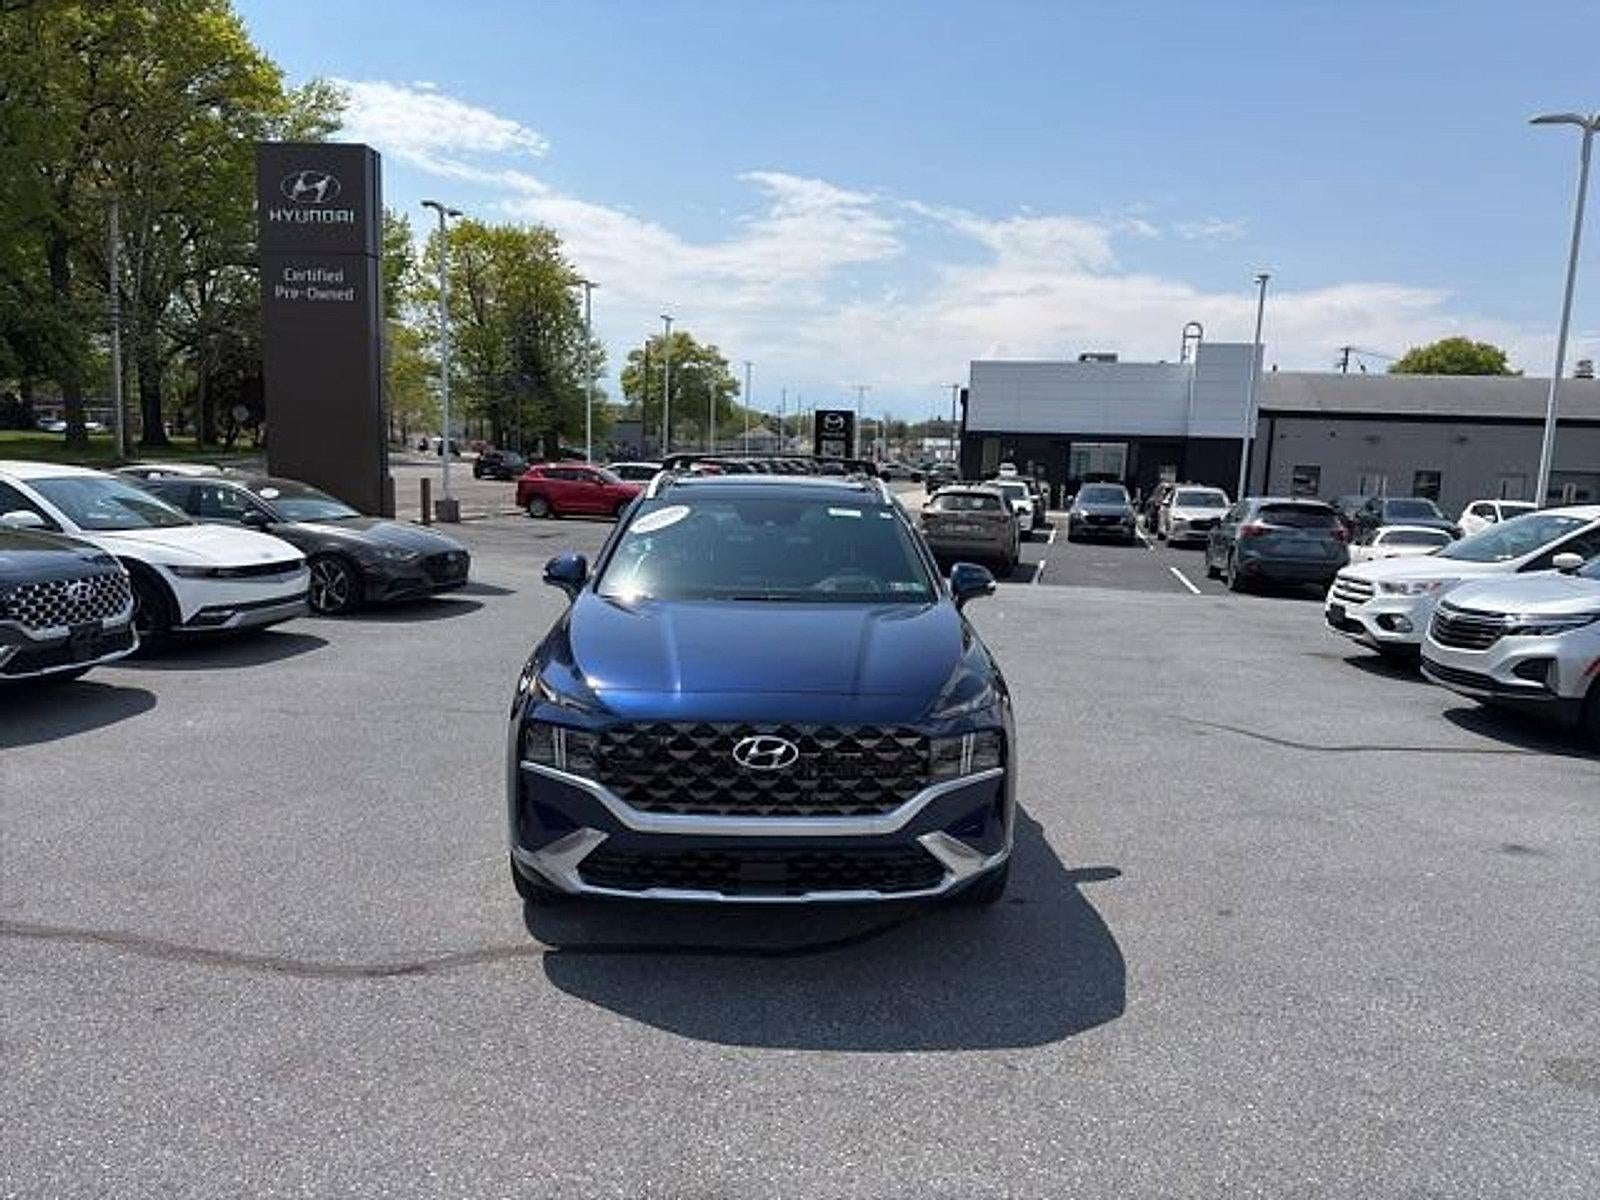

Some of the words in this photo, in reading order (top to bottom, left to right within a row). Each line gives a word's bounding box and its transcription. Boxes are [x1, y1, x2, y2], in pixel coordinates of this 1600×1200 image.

[269, 209, 354, 223] HYUNDAI
[284, 267, 344, 282] Certified
[275, 284, 354, 300] Pre-Owned
